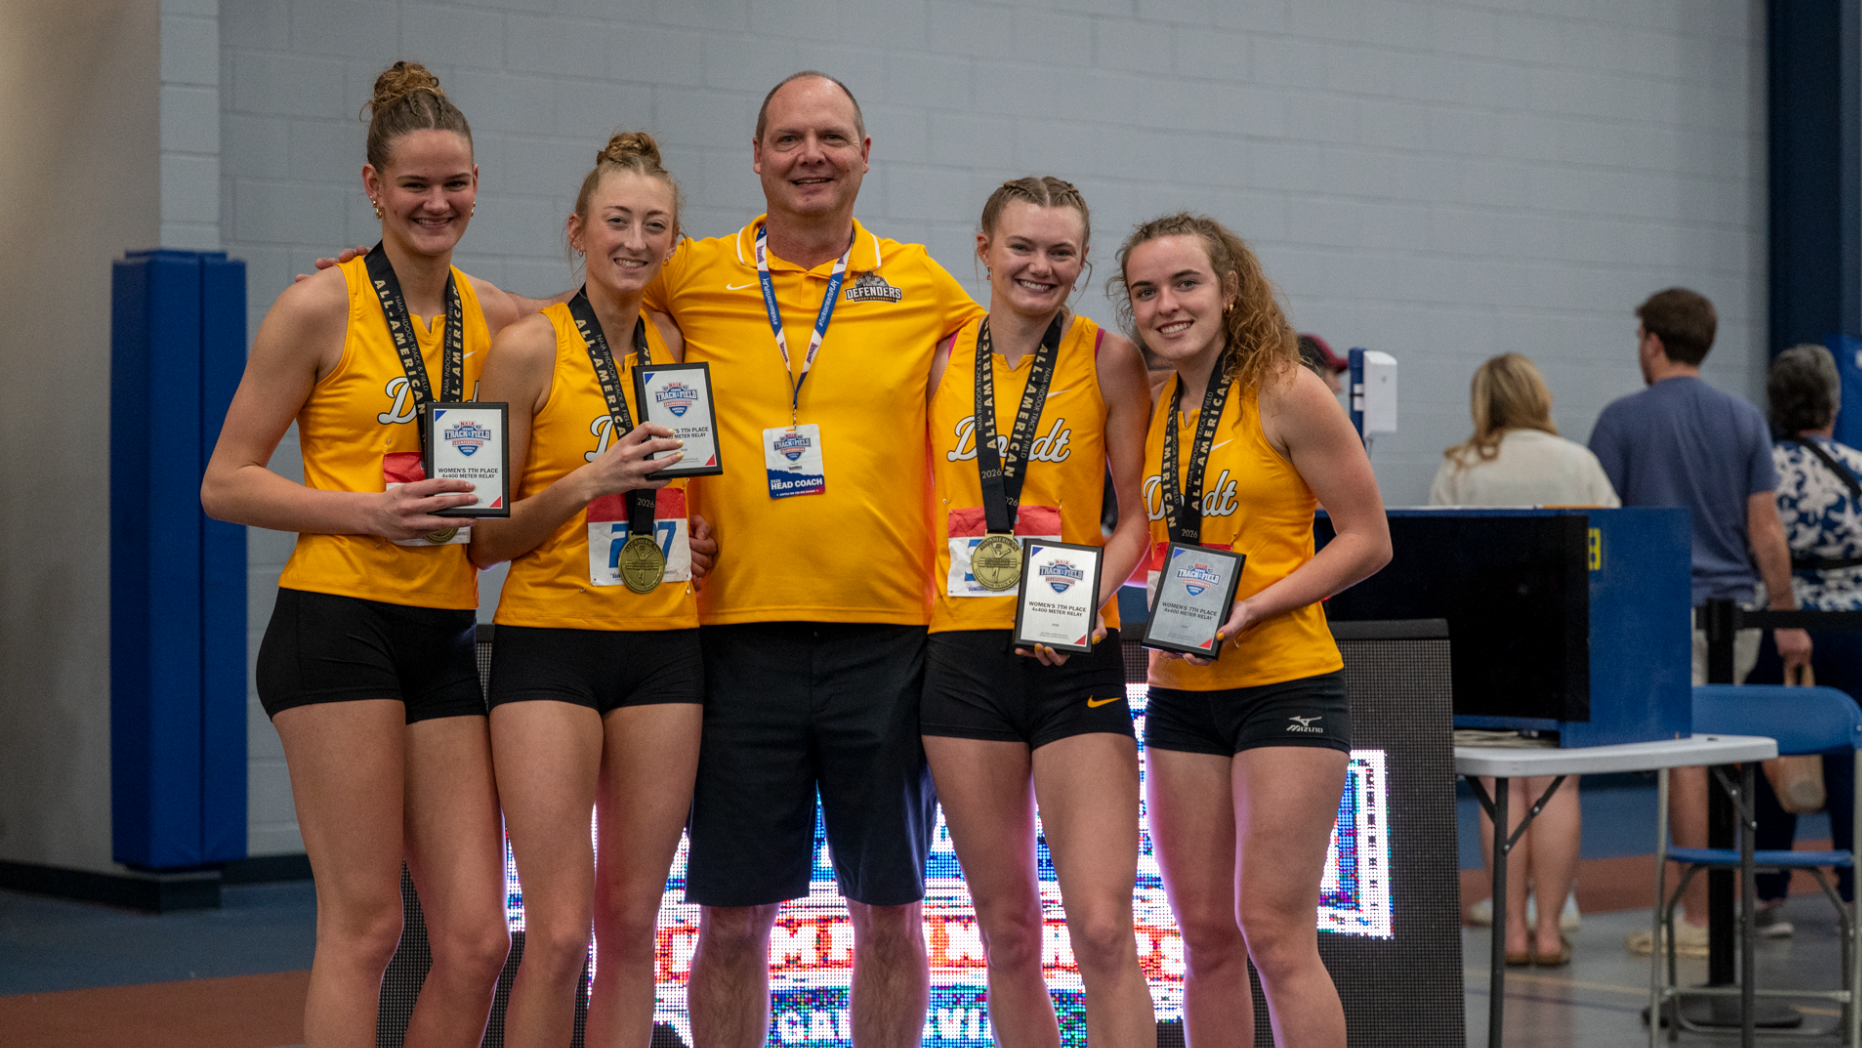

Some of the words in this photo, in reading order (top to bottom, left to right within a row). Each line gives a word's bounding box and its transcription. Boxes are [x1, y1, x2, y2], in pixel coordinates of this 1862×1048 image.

[846, 287, 901, 299] DEFENDERS
[374, 280, 426, 414] ALL-AMERICAN
[450, 286, 461, 402] L-AMERICAN
[420, 372, 429, 391] FIELD
[575, 319, 626, 437] ALL-AMERICA
[657, 391, 676, 400] TRACK
[680, 390, 697, 399] FIELD
[1204, 392, 1213, 409] FIELD
[622, 409, 632, 427] FIELD
[1004, 343, 1048, 477] ALL-AMERICAN
[445, 430, 467, 438] TRACK
[1021, 440, 1030, 458] FIELD
[1191, 374, 1231, 511] ALL-AMERICAN
[981, 468, 1002, 479] 2026
[771, 481, 793, 490] HEAD
[795, 478, 822, 487] COACH
[637, 498, 655, 508] 2026
[1181, 528, 1198, 538] 2026
[609, 521, 676, 568] 27
[1040, 566, 1060, 575] TRACK
[1064, 570, 1082, 580] FIELD
[1179, 569, 1199, 578] TRACK
[1201, 573, 1219, 584] FIELD
[1162, 602, 1187, 610] WOMEN'S
